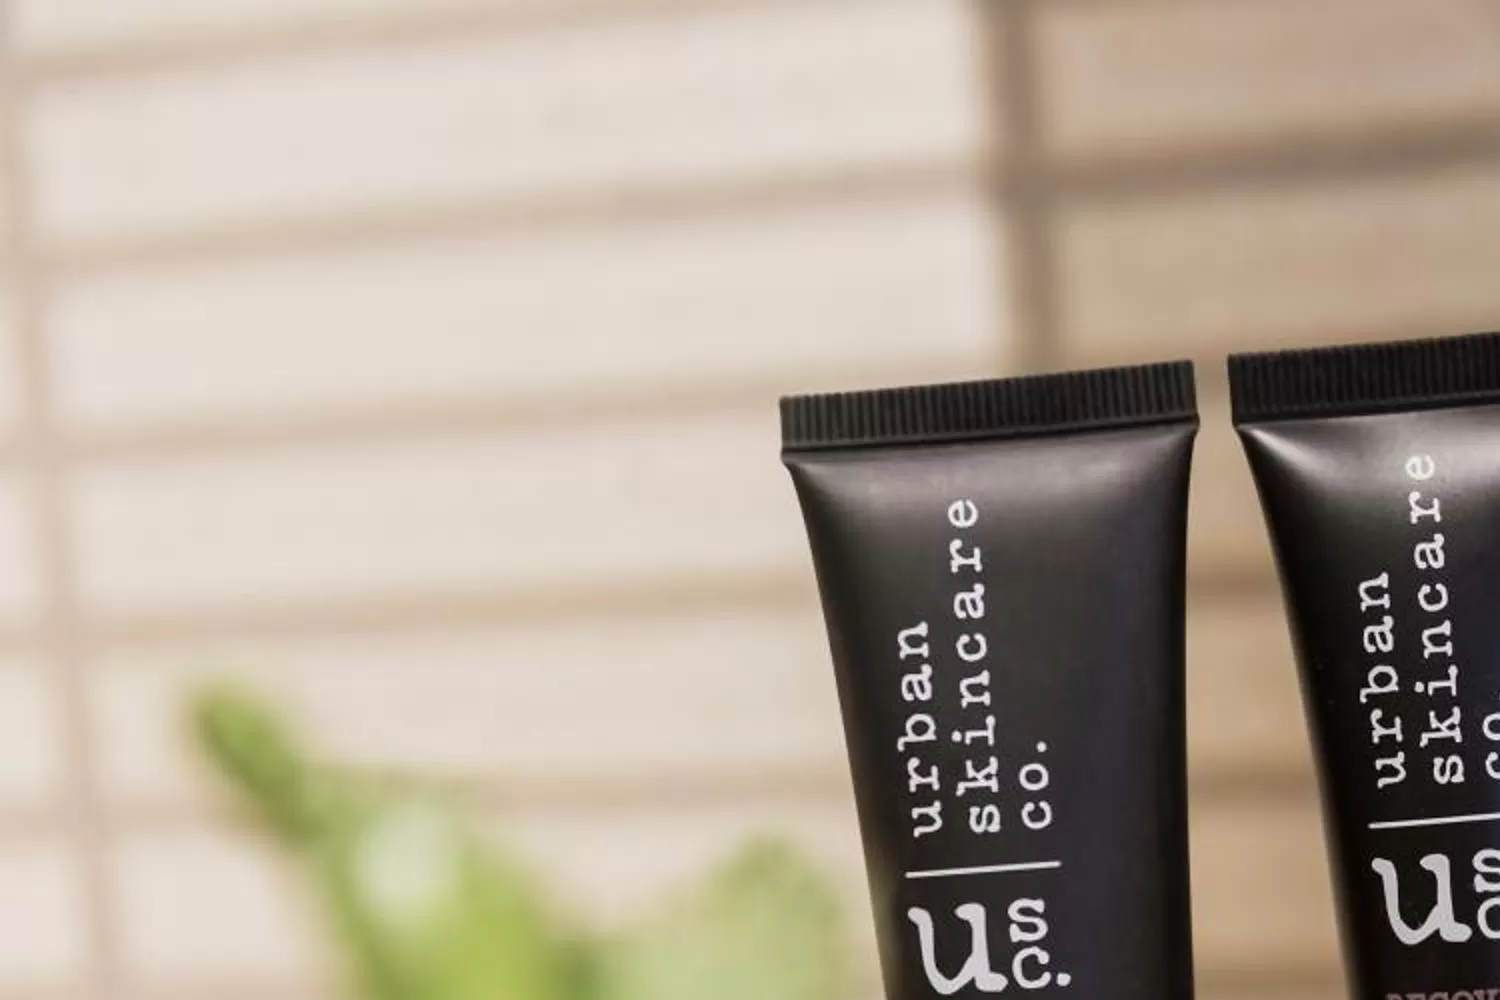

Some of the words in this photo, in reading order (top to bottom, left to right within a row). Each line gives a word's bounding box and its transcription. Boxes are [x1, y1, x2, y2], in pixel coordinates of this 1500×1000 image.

[948, 499, 1001, 834] skincare
[1358, 571, 1405, 789] urban
[1405, 453, 1465, 785] skincare
[896, 621, 944, 838] urban
[1018, 740, 1053, 830] co.
